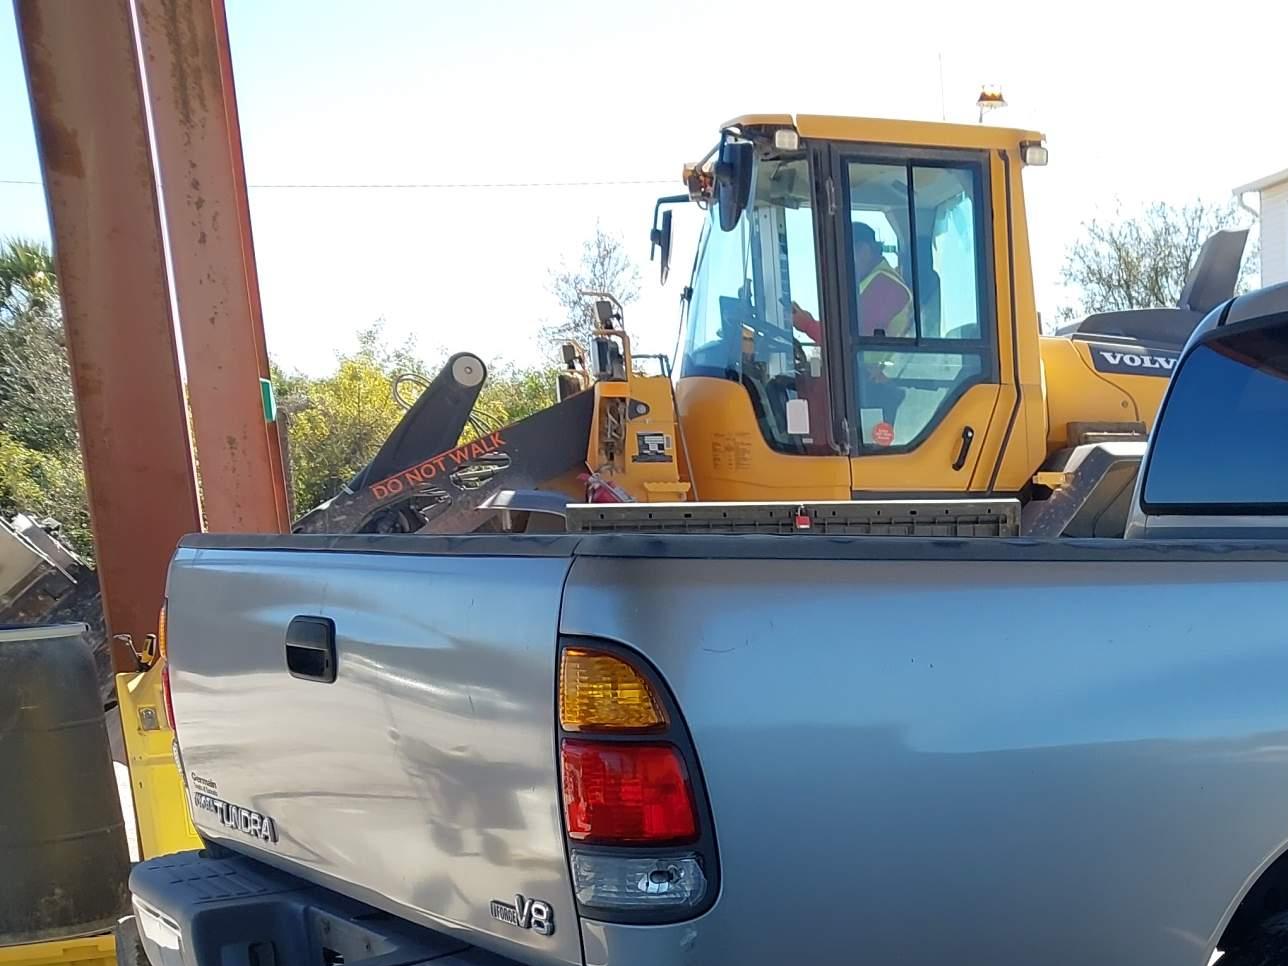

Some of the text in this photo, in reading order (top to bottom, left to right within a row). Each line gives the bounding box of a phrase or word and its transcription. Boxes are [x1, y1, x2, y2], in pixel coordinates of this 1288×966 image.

[1100, 351, 1178, 369] VOLV
[372, 432, 507, 500] DO NOT WALK
[214, 799, 279, 844] TUNDRA
[514, 893, 555, 936] V8
